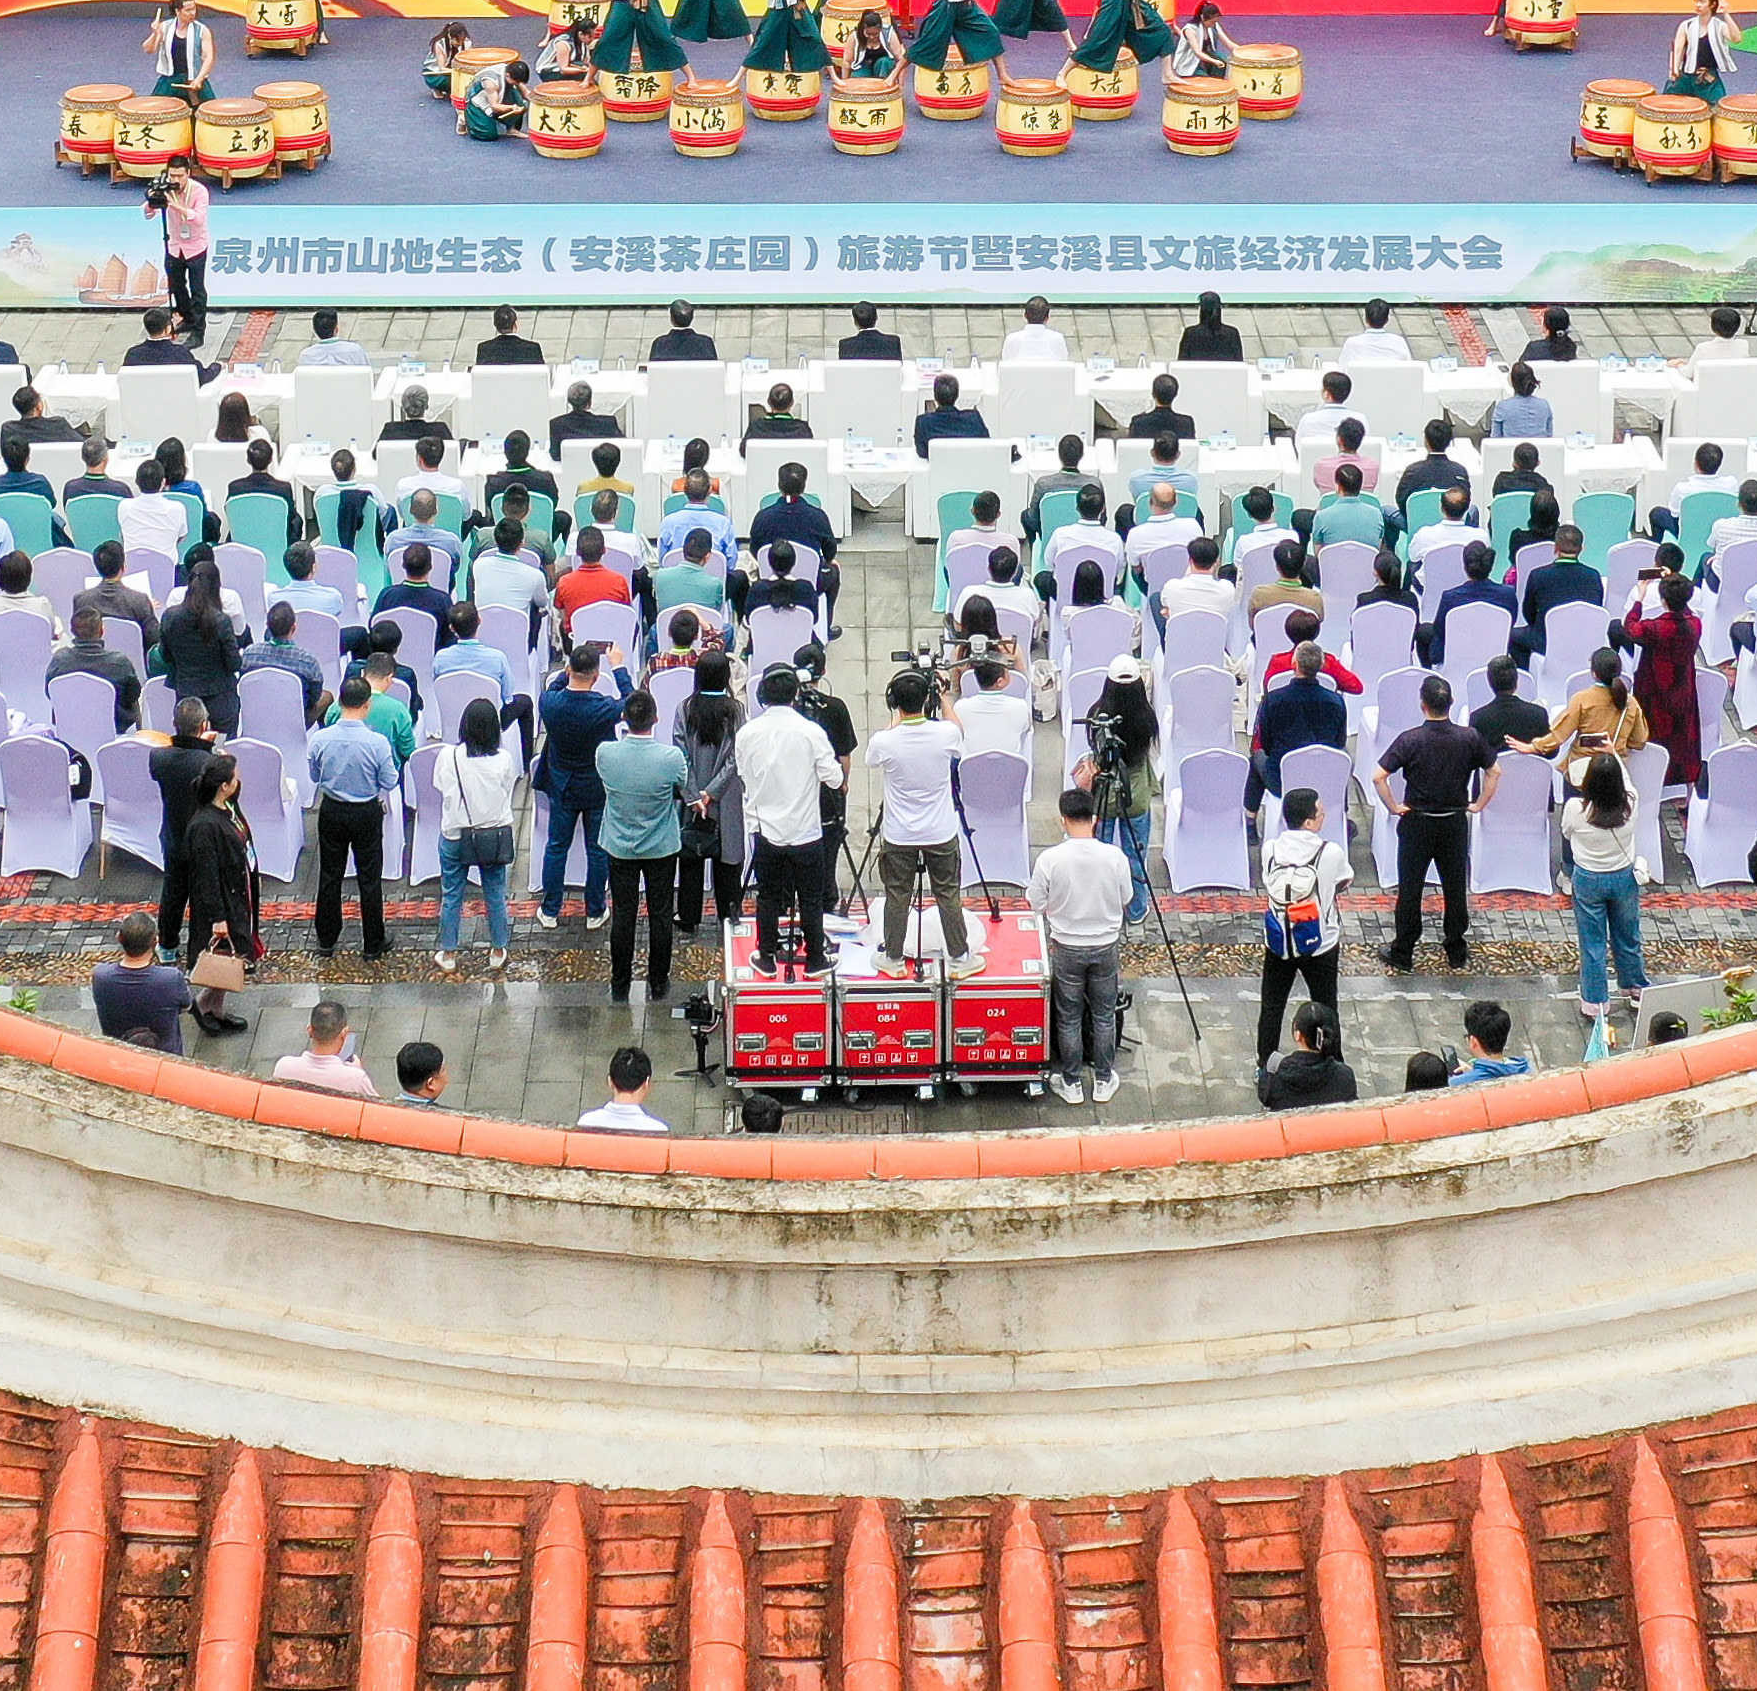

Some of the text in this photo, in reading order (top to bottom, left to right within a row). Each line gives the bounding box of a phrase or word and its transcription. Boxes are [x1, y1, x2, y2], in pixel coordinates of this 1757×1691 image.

[614, 75, 660, 99] 霜降
[538, 109, 581, 133] 大寒
[1186, 106, 1233, 130] 雨水
[118, 122, 165, 150] 立冬
[211, 234, 1504, 275] 泉州市山地生态（安溪茶庄园）旅游节暨安溪县文旅经济发展大会
[769, 1014, 788, 1023] 006
[877, 1014, 897, 1023] 084
[986, 1008, 1006, 1018] 024
